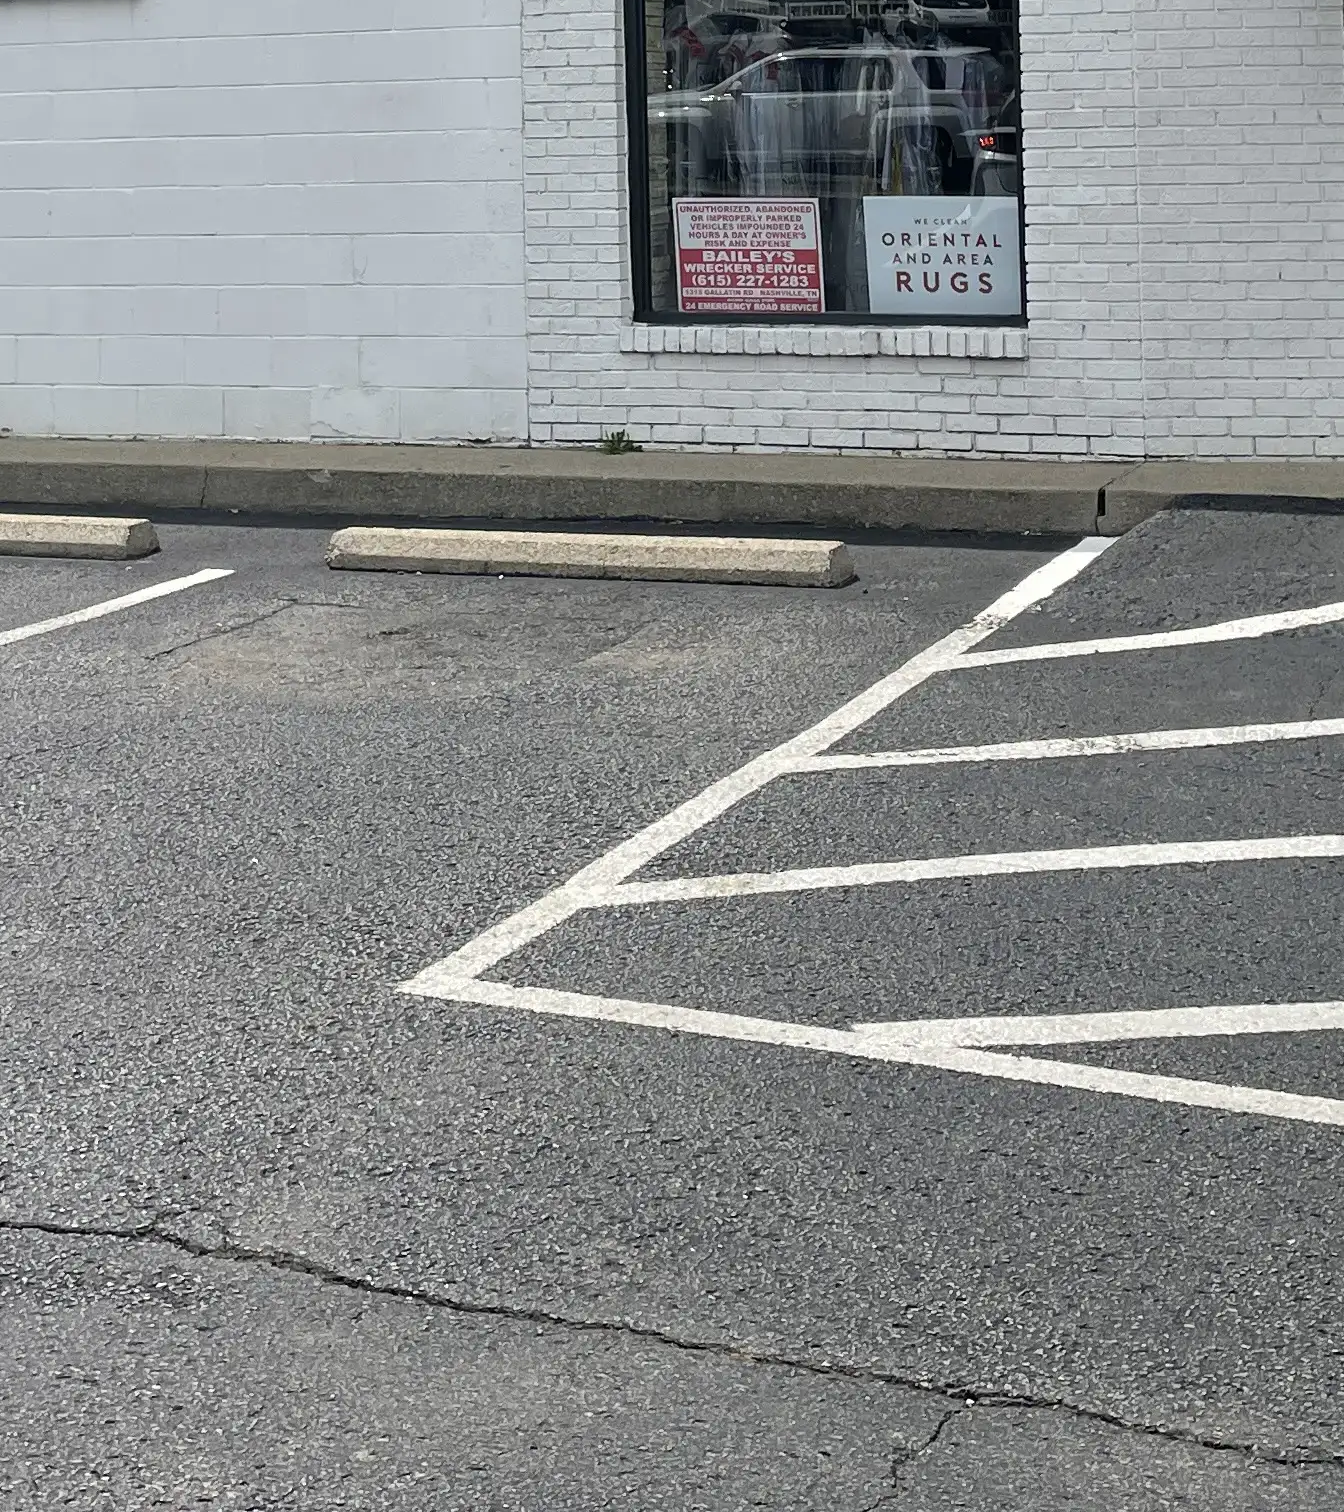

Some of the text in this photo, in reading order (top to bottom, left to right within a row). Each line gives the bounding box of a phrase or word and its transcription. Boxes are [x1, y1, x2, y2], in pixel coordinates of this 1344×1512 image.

[679, 206, 753, 214] UNAUTHORIZED,
[691, 214, 801, 222] OR IMPROPERLY PARKED
[882, 232, 1002, 247] ORIENTAL
[703, 251, 795, 263] BAILEY'S
[892, 253, 993, 265] AND AREA
[684, 264, 816, 274] WRECKER SERVICE
[692, 275, 809, 287] (615) 227-1283
[896, 271, 993, 294] RUGS
[780, 303, 818, 311] SERVICE
